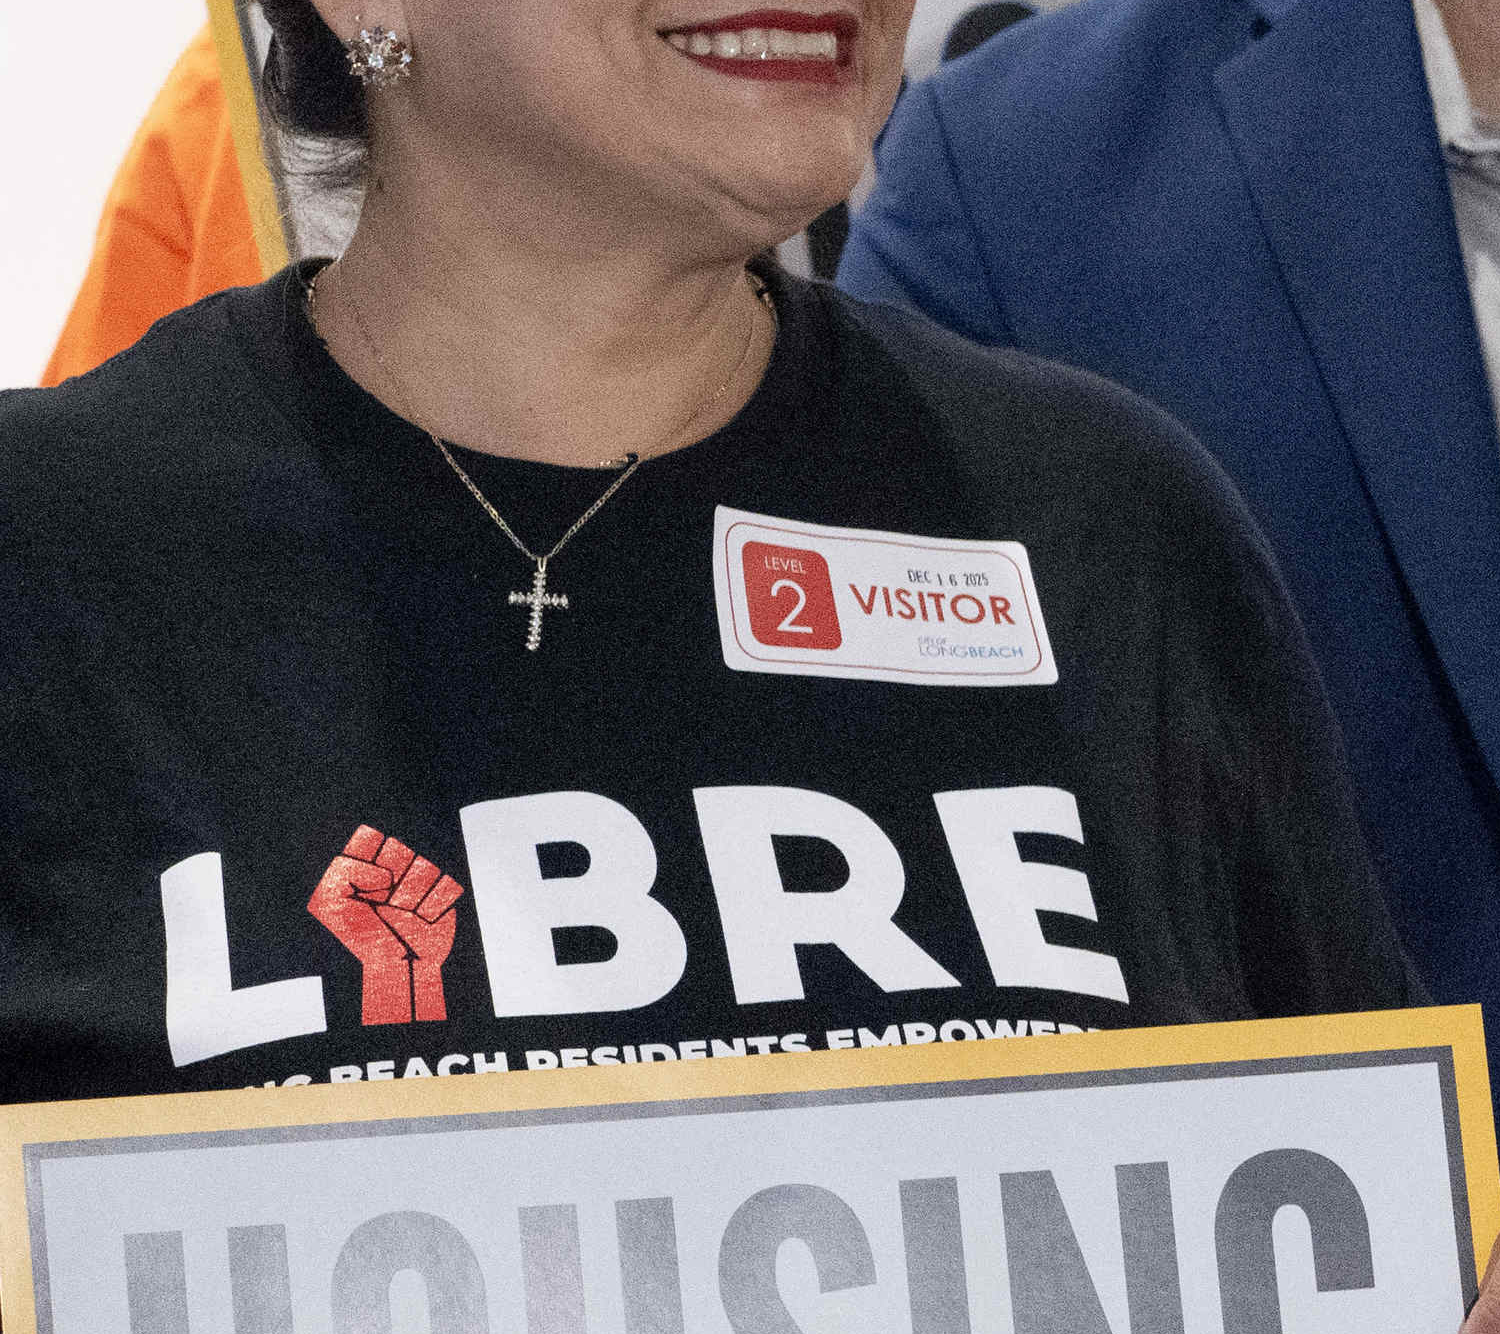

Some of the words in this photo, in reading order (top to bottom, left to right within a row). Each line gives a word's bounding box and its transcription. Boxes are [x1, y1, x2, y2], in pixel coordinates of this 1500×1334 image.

[764, 556, 807, 574] LEVEL
[907, 569, 932, 584] DEC
[770, 578, 814, 634] 2
[849, 584, 1016, 625] VISITOR
